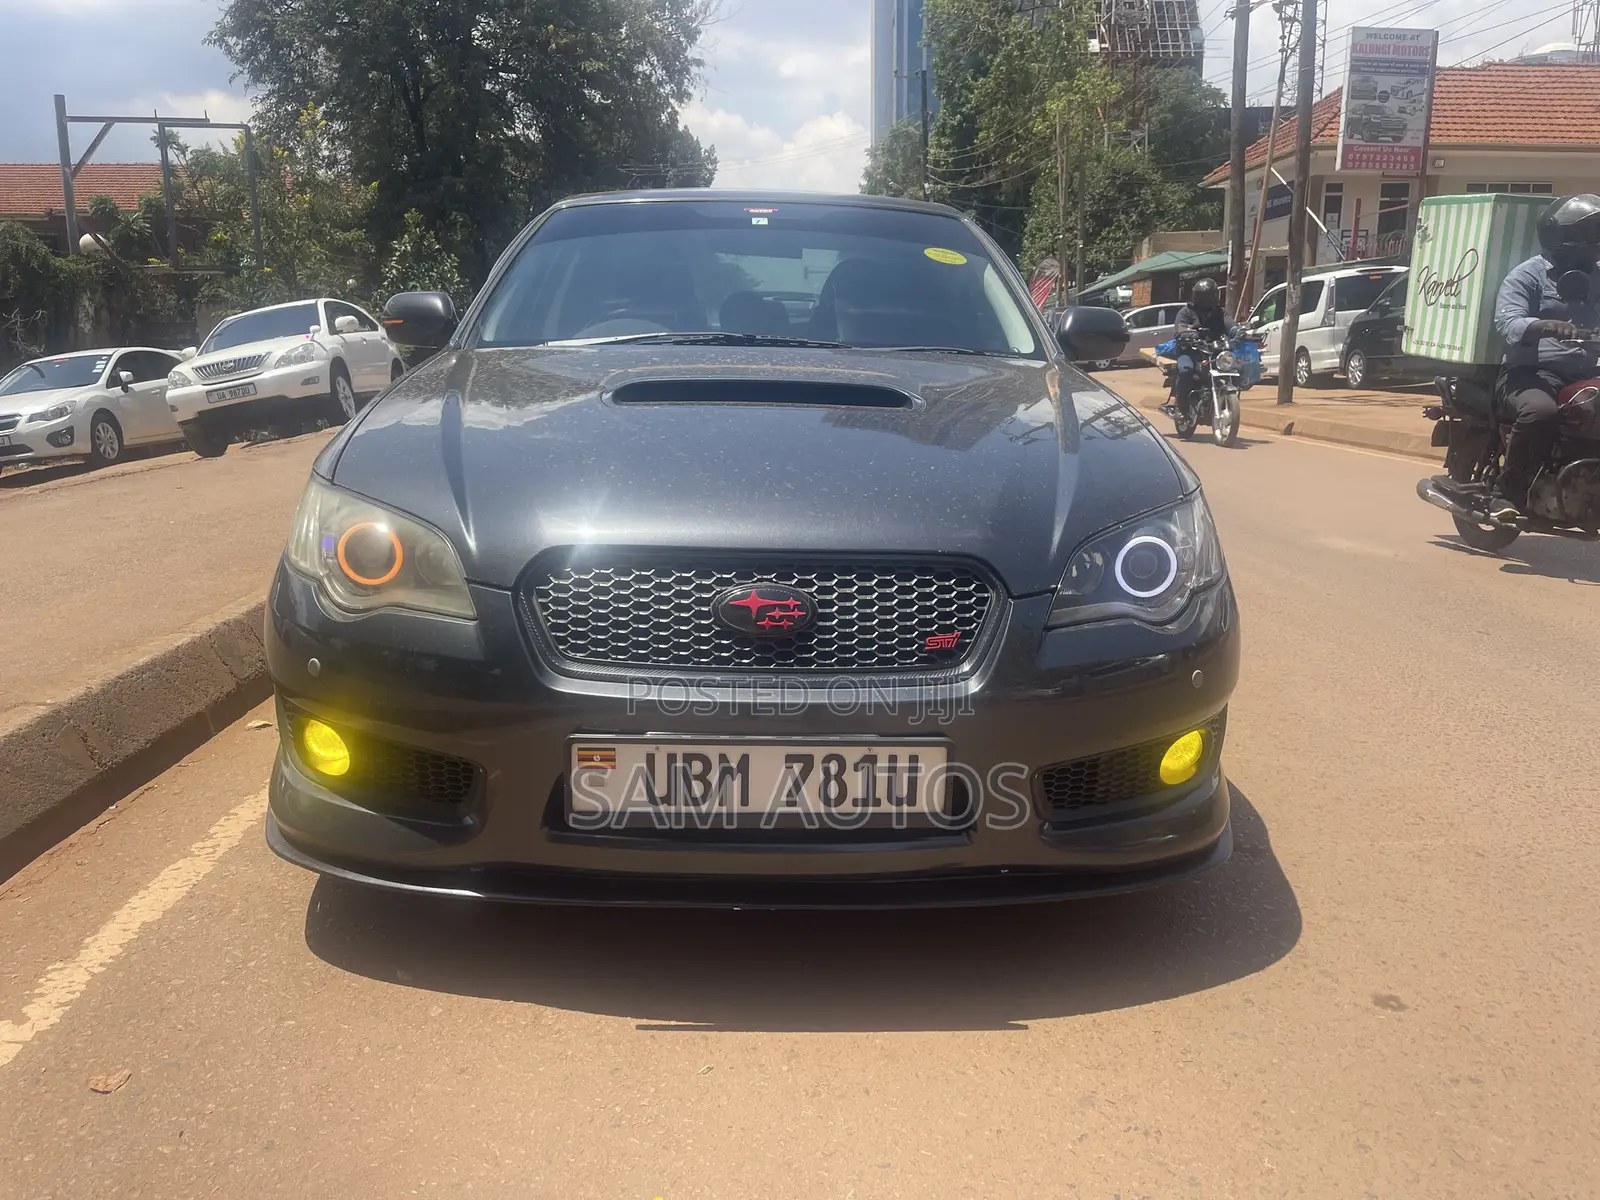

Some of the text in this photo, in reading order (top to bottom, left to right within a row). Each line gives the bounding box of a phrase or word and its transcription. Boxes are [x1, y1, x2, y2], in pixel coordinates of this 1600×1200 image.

[1391, 44, 1431, 57] MOTORS
[645, 753, 919, 808] UBM 781U
